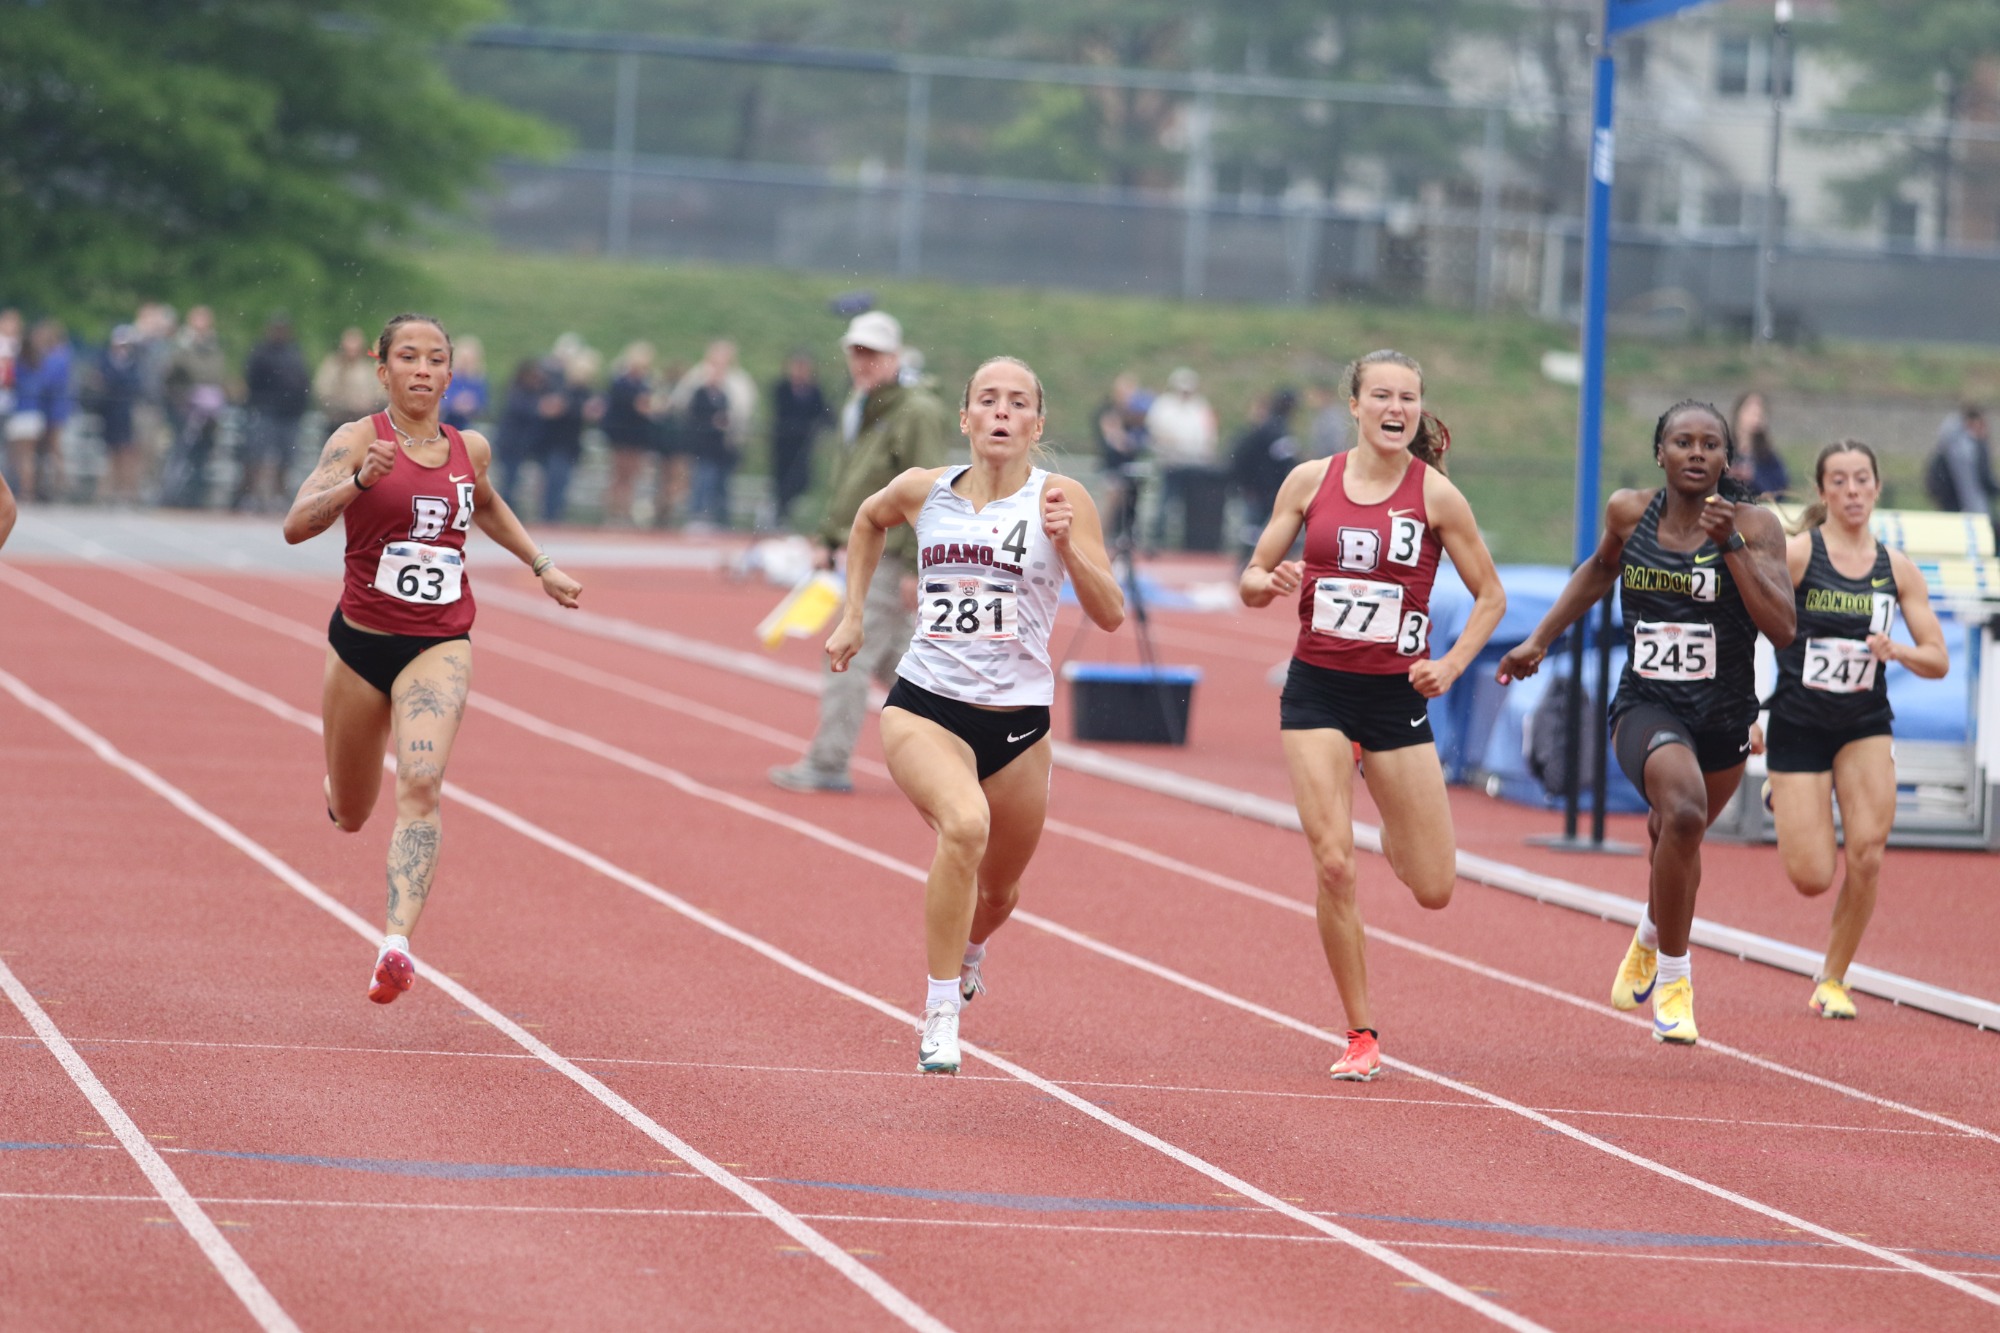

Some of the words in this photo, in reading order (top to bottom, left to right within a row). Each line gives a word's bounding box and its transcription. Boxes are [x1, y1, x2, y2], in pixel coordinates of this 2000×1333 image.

[408, 495, 450, 541] B
[459, 486, 473, 528] 5
[1001, 519, 1028, 563] 4
[1337, 526, 1382, 573] B
[1395, 521, 1416, 561] 3
[922, 543, 1024, 576] ROANO
[396, 564, 445, 601] 63
[1624, 564, 1720, 597] RANDOL
[1692, 570, 1707, 599] 2
[930, 598, 1004, 634] 281
[1333, 598, 1380, 633] 77
[1881, 599, 1890, 633] 1
[1403, 615, 1423, 654] 3
[1640, 640, 1707, 673] 245
[1810, 655, 1871, 686] 247
